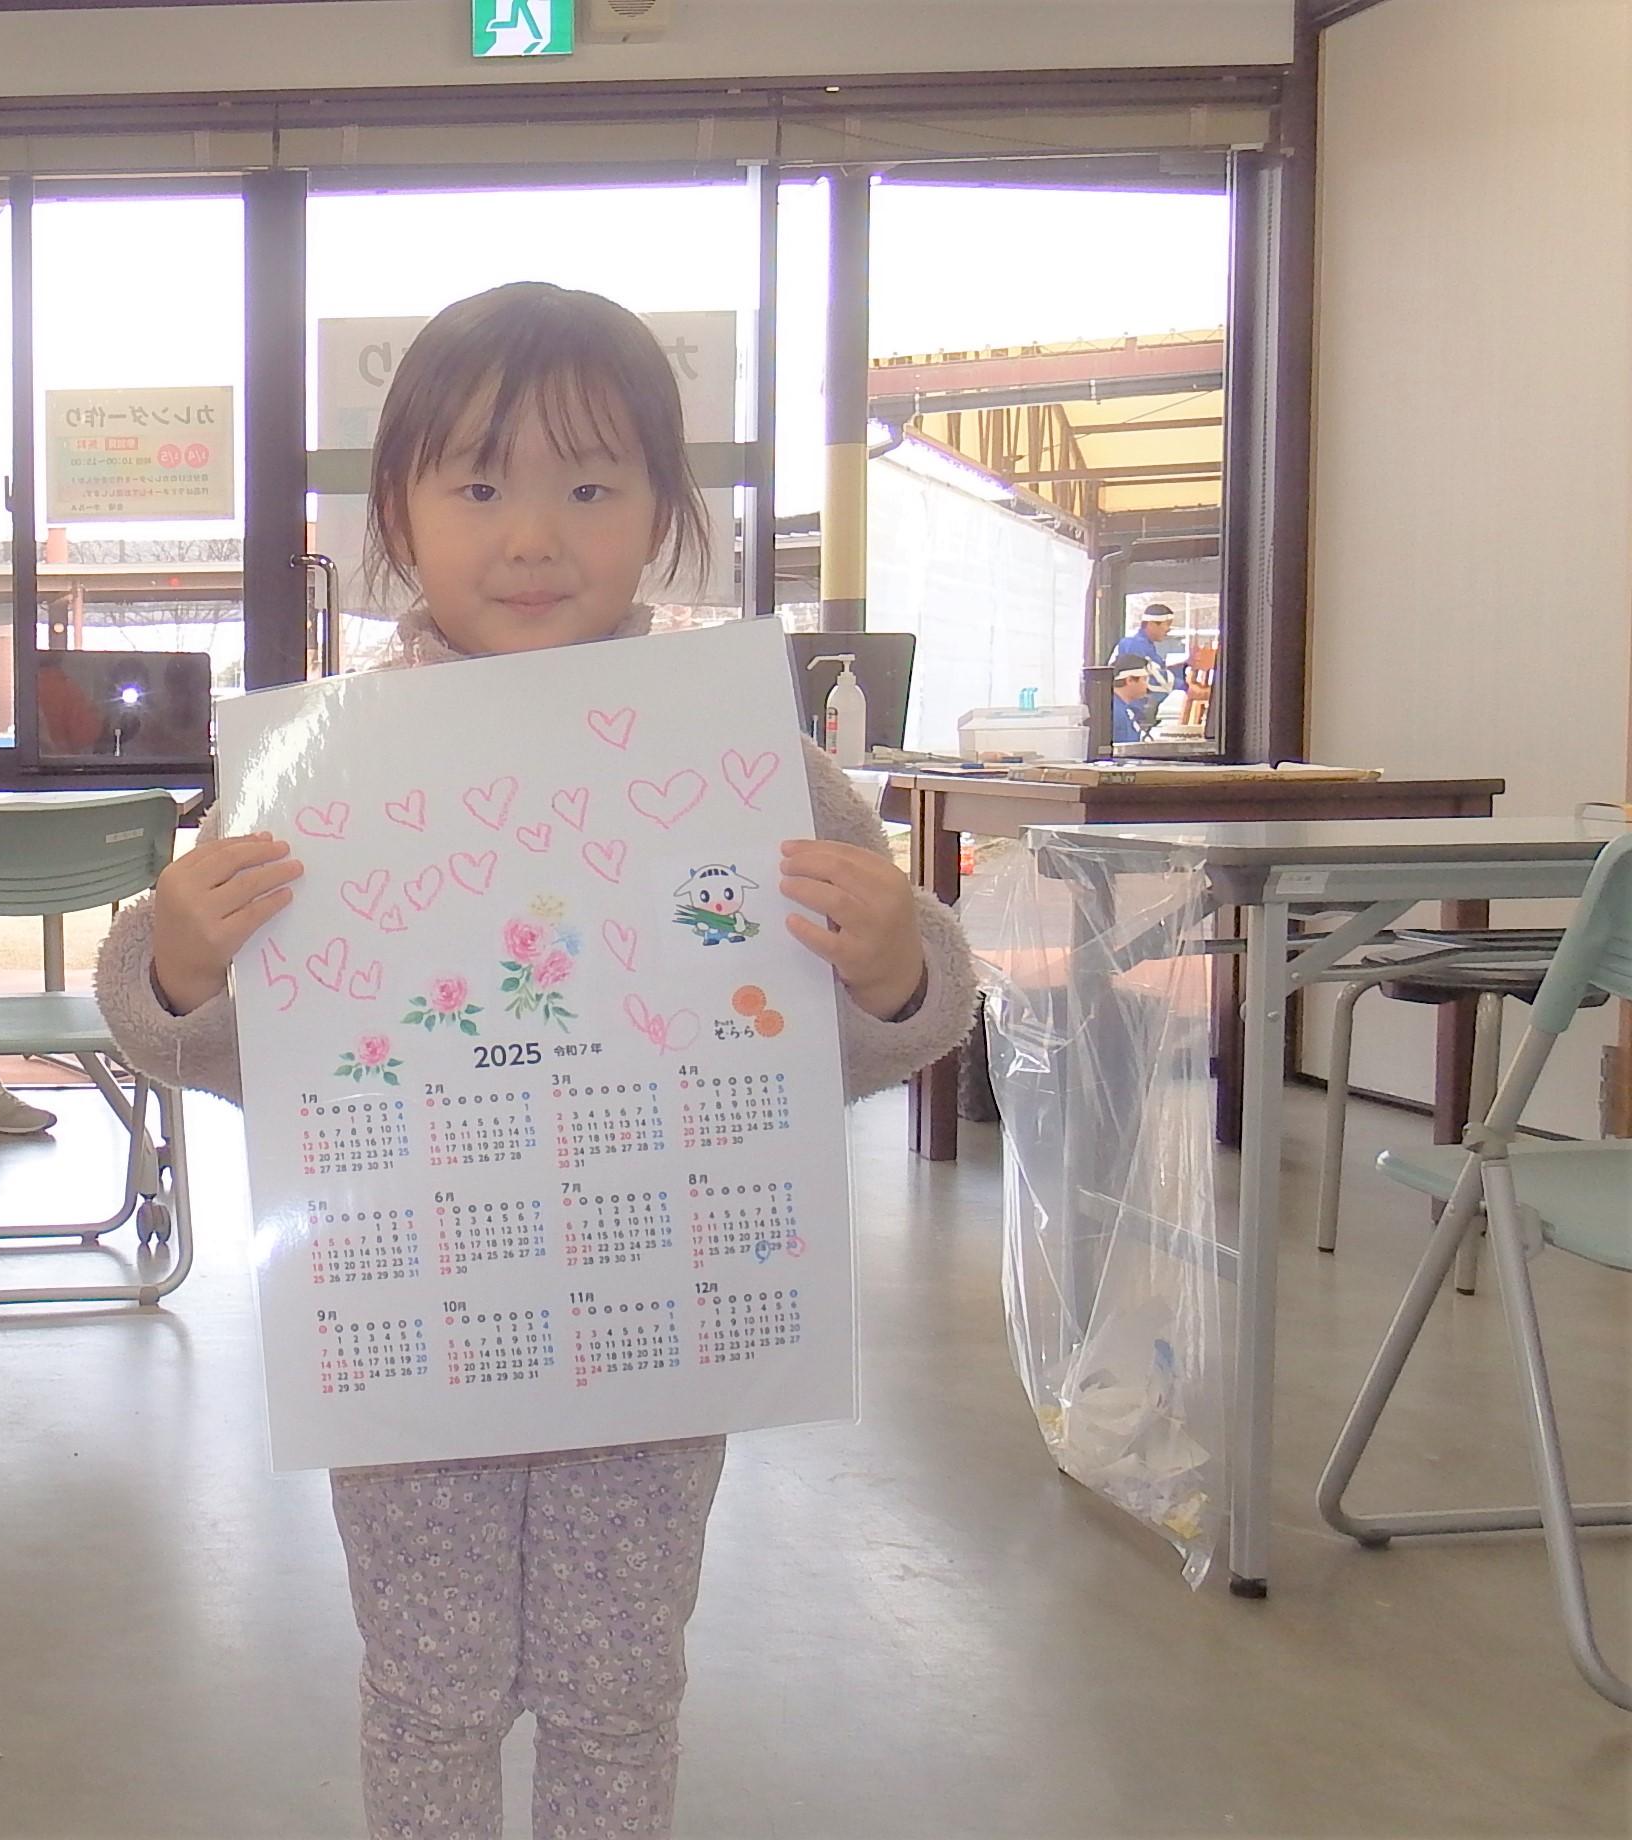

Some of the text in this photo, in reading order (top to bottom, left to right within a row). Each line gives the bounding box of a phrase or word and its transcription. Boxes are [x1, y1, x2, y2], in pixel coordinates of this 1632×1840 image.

[473, 1042, 543, 1068] 2025
[678, 1065, 699, 1076] 4月
[552, 1073, 571, 1085] 3月
[425, 1083, 444, 1095] 2月
[301, 1093, 318, 1104] 1月
[715, 1113, 725, 1121] 15
[731, 1112, 741, 1120] 16
[747, 1111, 757, 1119] 17
[778, 1109, 788, 1117] 19
[572, 1123, 582, 1131] 10
[588, 1122, 597, 1130] 11
[604, 1121, 614, 1129] 12
[620, 1120, 630, 1128] 13
[652, 1118, 662, 1126] 15
[461, 1131, 470, 1139] 11
[477, 1130, 487, 1138] 12
[493, 1129, 503, 1137] 13
[509, 1128, 519, 1136] 14
[525, 1127, 535, 1135] 15
[303, 1143, 313, 1151] 12
[319, 1141, 329, 1150] 13
[350, 1139, 360, 1147] 15
[366, 1138, 376, 1146] 16
[382, 1137, 392, 1145] 17
[398, 1136, 408, 1144] 18
[688, 1173, 708, 1185] 8月
[561, 1182, 581, 1194] 7月
[434, 1191, 454, 1203] 6月
[308, 1200, 327, 1212] 5月
[440, 1255, 450, 1263] 22
[456, 1254, 466, 1262] 23
[472, 1253, 482, 1261] 24
[487, 1251, 498, 1260] 25
[520, 1249, 529, 1257] 27
[535, 1248, 545, 1256] 28
[695, 1282, 718, 1294] 12月
[569, 1292, 594, 1304] 11月
[442, 1300, 467, 1313] 10月
[317, 1310, 337, 1321] 9月
[337, 1360, 347, 1368] 15
[369, 1358, 379, 1366] 17
[401, 1356, 411, 1364] 19
[416, 1355, 427, 1363] 20
